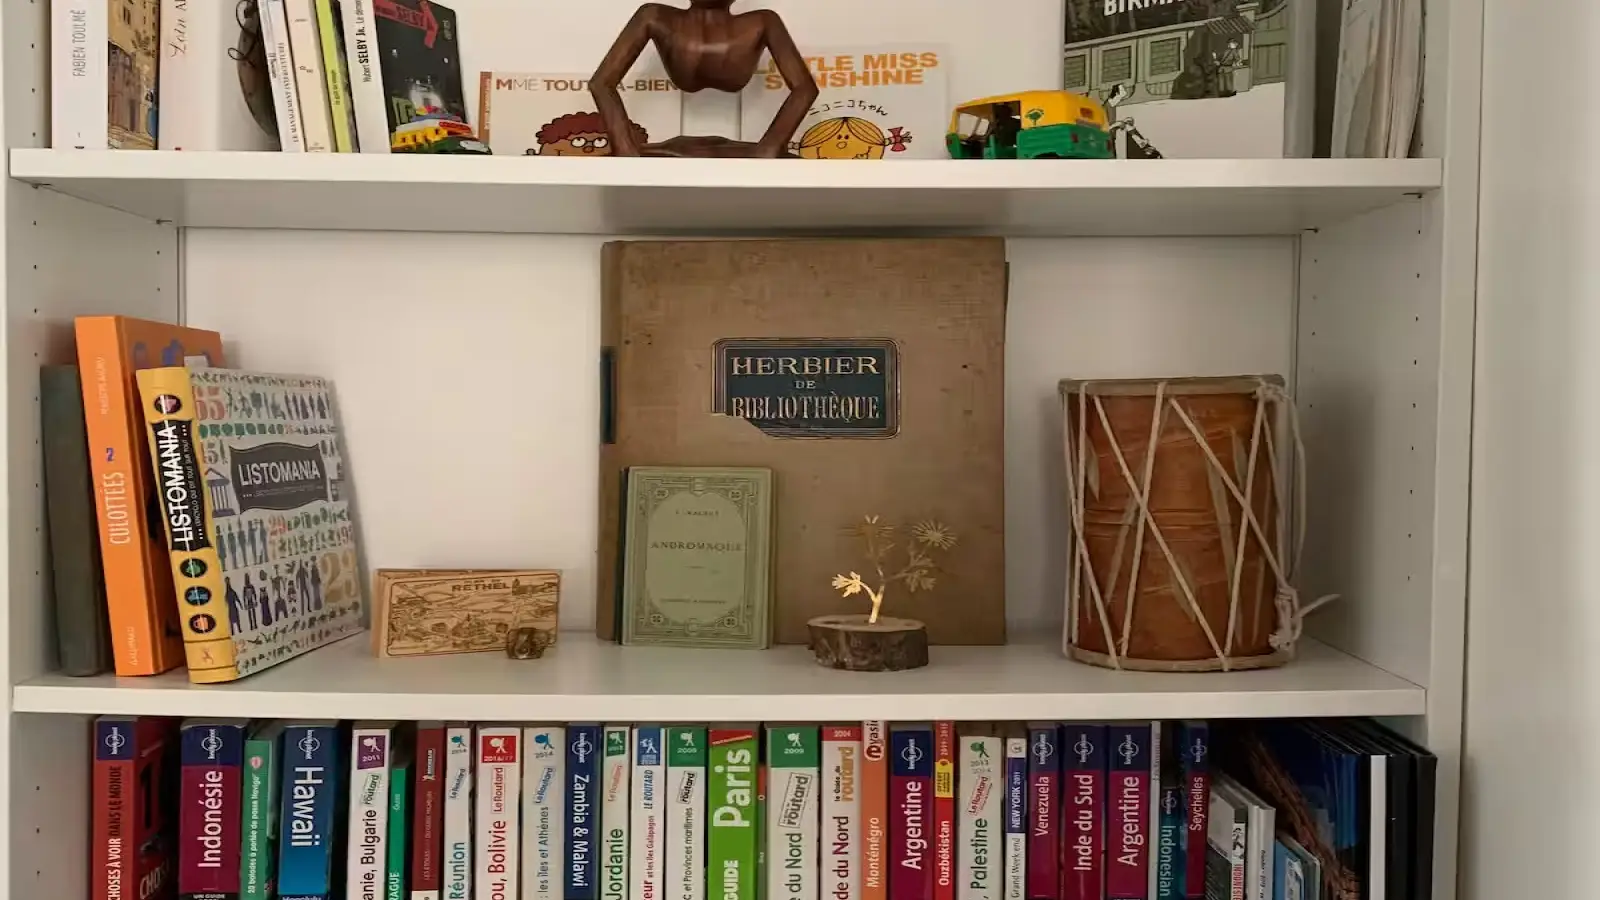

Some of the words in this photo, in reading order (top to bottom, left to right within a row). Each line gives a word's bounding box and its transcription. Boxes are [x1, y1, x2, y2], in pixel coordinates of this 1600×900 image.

[70, 9, 86, 44] TOULMÉ
[72, 47, 86, 77] FABIEN
[356, 39, 369, 64] SELBY
[862, 52, 939, 71] MISS
[766, 69, 924, 90] SNSHINE
[731, 356, 881, 375] HERBIER
[795, 380, 816, 389] DE
[731, 391, 880, 424] BIBLIOTHÈQUE
[157, 425, 194, 542] LISTOMANIA
[186, 465, 194, 479] TOUT
[238, 459, 321, 486] LISTOMANIA
[101, 472, 130, 544] CULOTTÉES
[650, 541, 743, 552] ANDROMAQUE
[451, 581, 511, 592] RETHEL
[362, 754, 381, 763] 2011
[109, 766, 122, 799] MONDE
[643, 769, 654, 801] ROUTARD
[680, 773, 696, 803] routard
[713, 748, 752, 827] Paris
[833, 777, 841, 794] Guide
[838, 746, 854, 802] routard
[363, 774, 380, 805] routard
[573, 774, 590, 823] Zambia
[786, 776, 809, 825] routard
[1011, 787, 1021, 809] YORK
[1073, 774, 1094, 805] Sud
[1189, 777, 1206, 831] Seychelles
[109, 800, 122, 811] LE
[197, 771, 223, 868] Indonésie
[291, 767, 324, 847] Hawaii
[644, 802, 654, 810] LE
[1011, 809, 1021, 829] NEW
[1033, 776, 1050, 837] Venezuela
[1073, 810, 1093, 831] du
[109, 812, 122, 837] DANS
[536, 807, 550, 846] Athènes
[572, 827, 589, 837] &
[683, 808, 693, 845] maritimes
[832, 816, 849, 855] Nord
[901, 781, 927, 870] Argentine
[1117, 776, 1144, 866] Argentine
[108, 838, 121, 859] VOIR
[360, 810, 381, 865] Bulgarie
[487, 820, 506, 874] Bolivie
[785, 833, 802, 869] Nord
[866, 817, 882, 888] Monténégro
[105, 859, 121, 868] À
[537, 849, 549, 859] et
[571, 840, 589, 887] Malawi
[605, 828, 624, 900] Jordanie
[646, 862, 654, 871] les
[683, 846, 693, 882] Provinces
[938, 820, 950, 886] Ouzbékistan
[970, 818, 988, 890] Palestine
[1010, 853, 1021, 874] Week
[1073, 845, 1092, 871] Inde
[1159, 825, 1177, 897] Indonesian
[248, 858, 257, 885] balades
[448, 842, 466, 900] Réunion
[723, 860, 739, 900] GUIDE
[785, 873, 802, 893] du
[832, 860, 849, 878] du
[536, 880, 549, 893] les
[642, 880, 653, 900] eur
[683, 883, 693, 891] et
[1010, 875, 1021, 898] Grand
